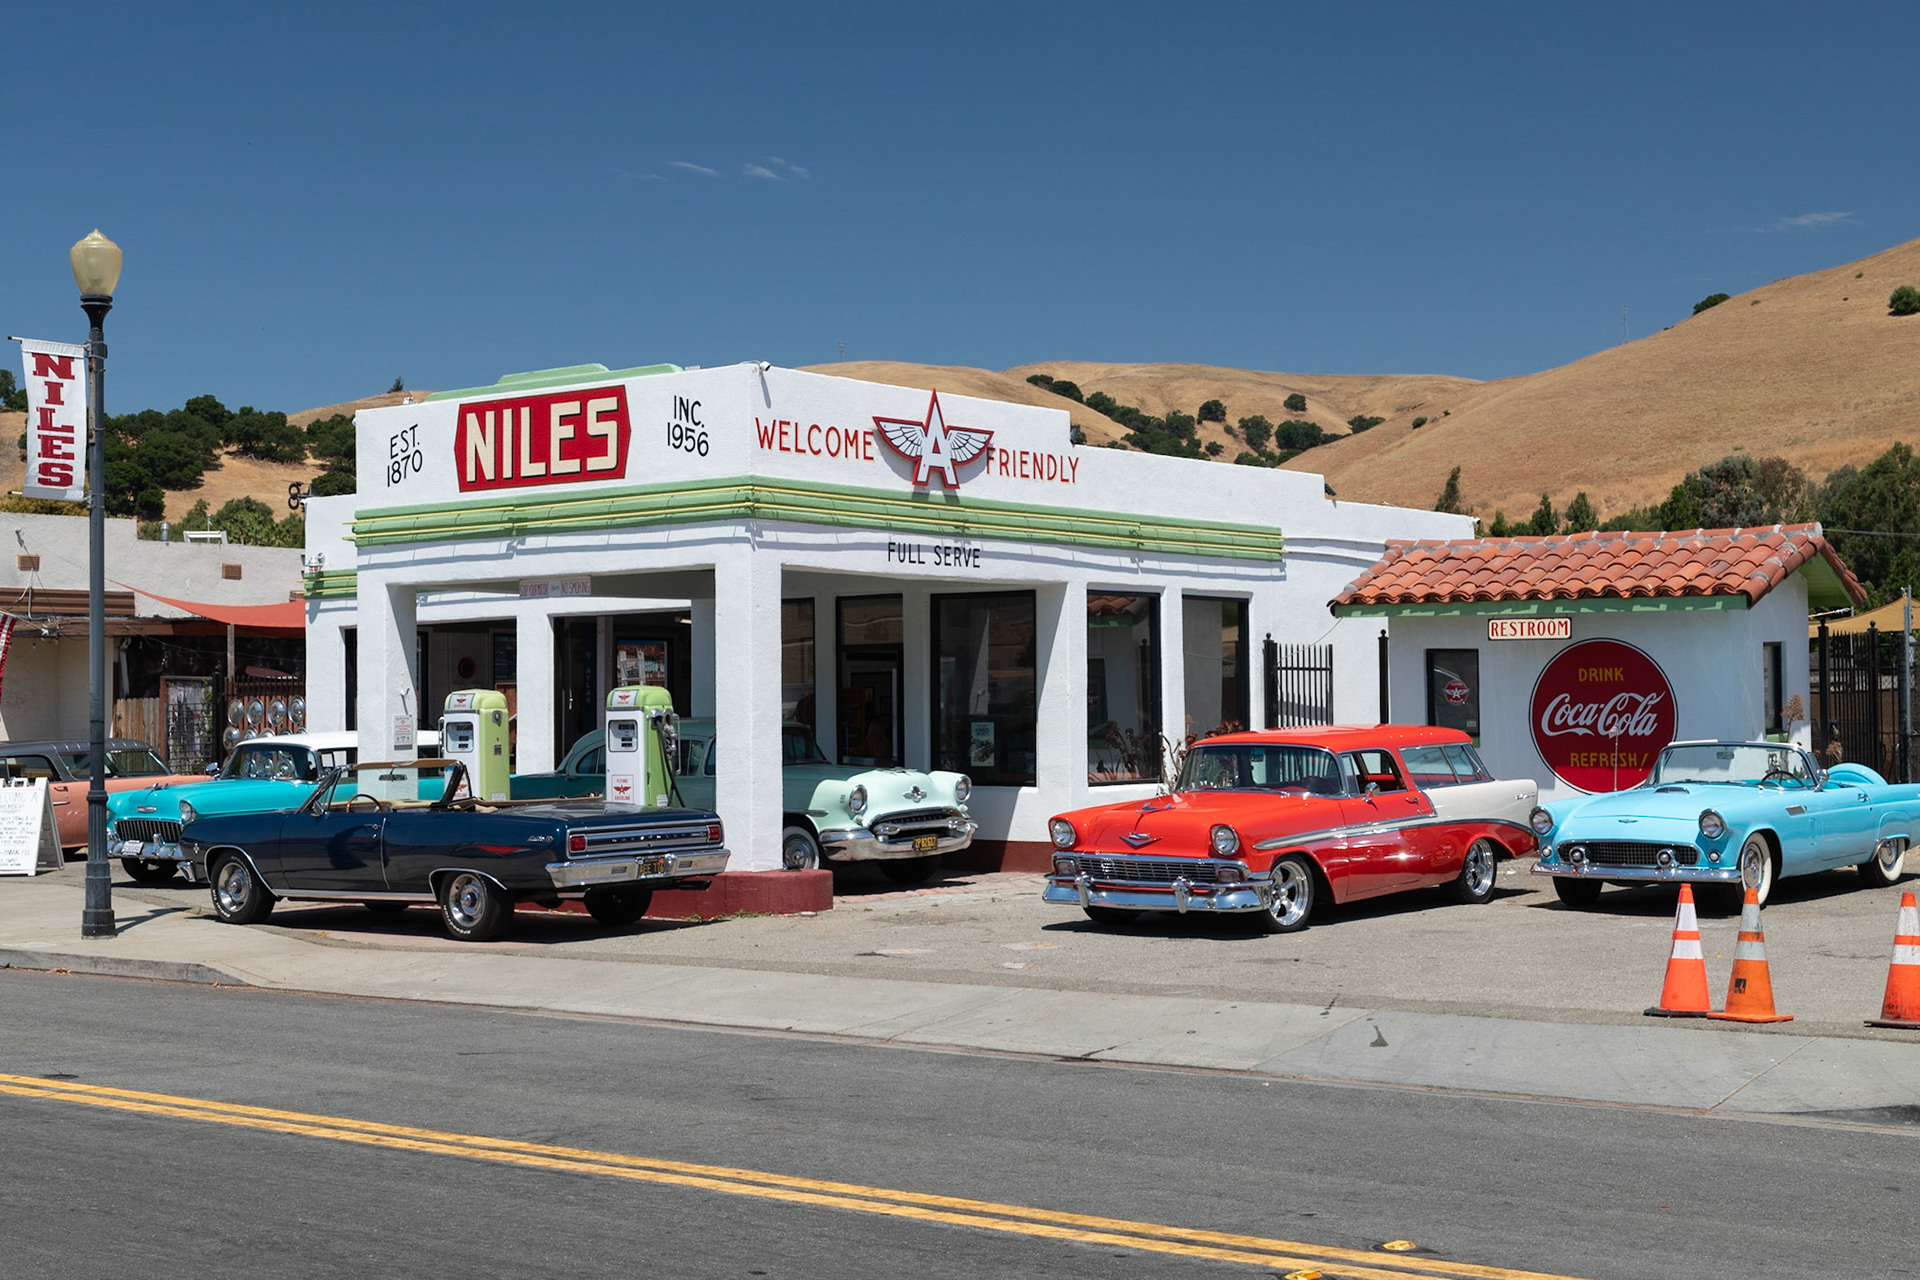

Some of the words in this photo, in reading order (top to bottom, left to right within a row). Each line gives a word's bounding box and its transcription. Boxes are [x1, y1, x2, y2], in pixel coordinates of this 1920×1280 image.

[31, 352, 75, 487] NILES
[674, 395, 705, 428] INC.
[390, 423, 420, 460] EST.
[466, 396, 619, 483] NILES
[667, 422, 709, 457] 1956
[755, 417, 875, 461] WELCOME
[986, 447, 1079, 484] FRIENDLY
[387, 449, 423, 488] 1870
[888, 542, 926, 564] FULL
[934, 545, 981, 568] SERVE
[1491, 620, 1569, 637] RESTROOM
[1578, 667, 1624, 682] DRINK
[1541, 691, 1666, 736] Coca-Cola
